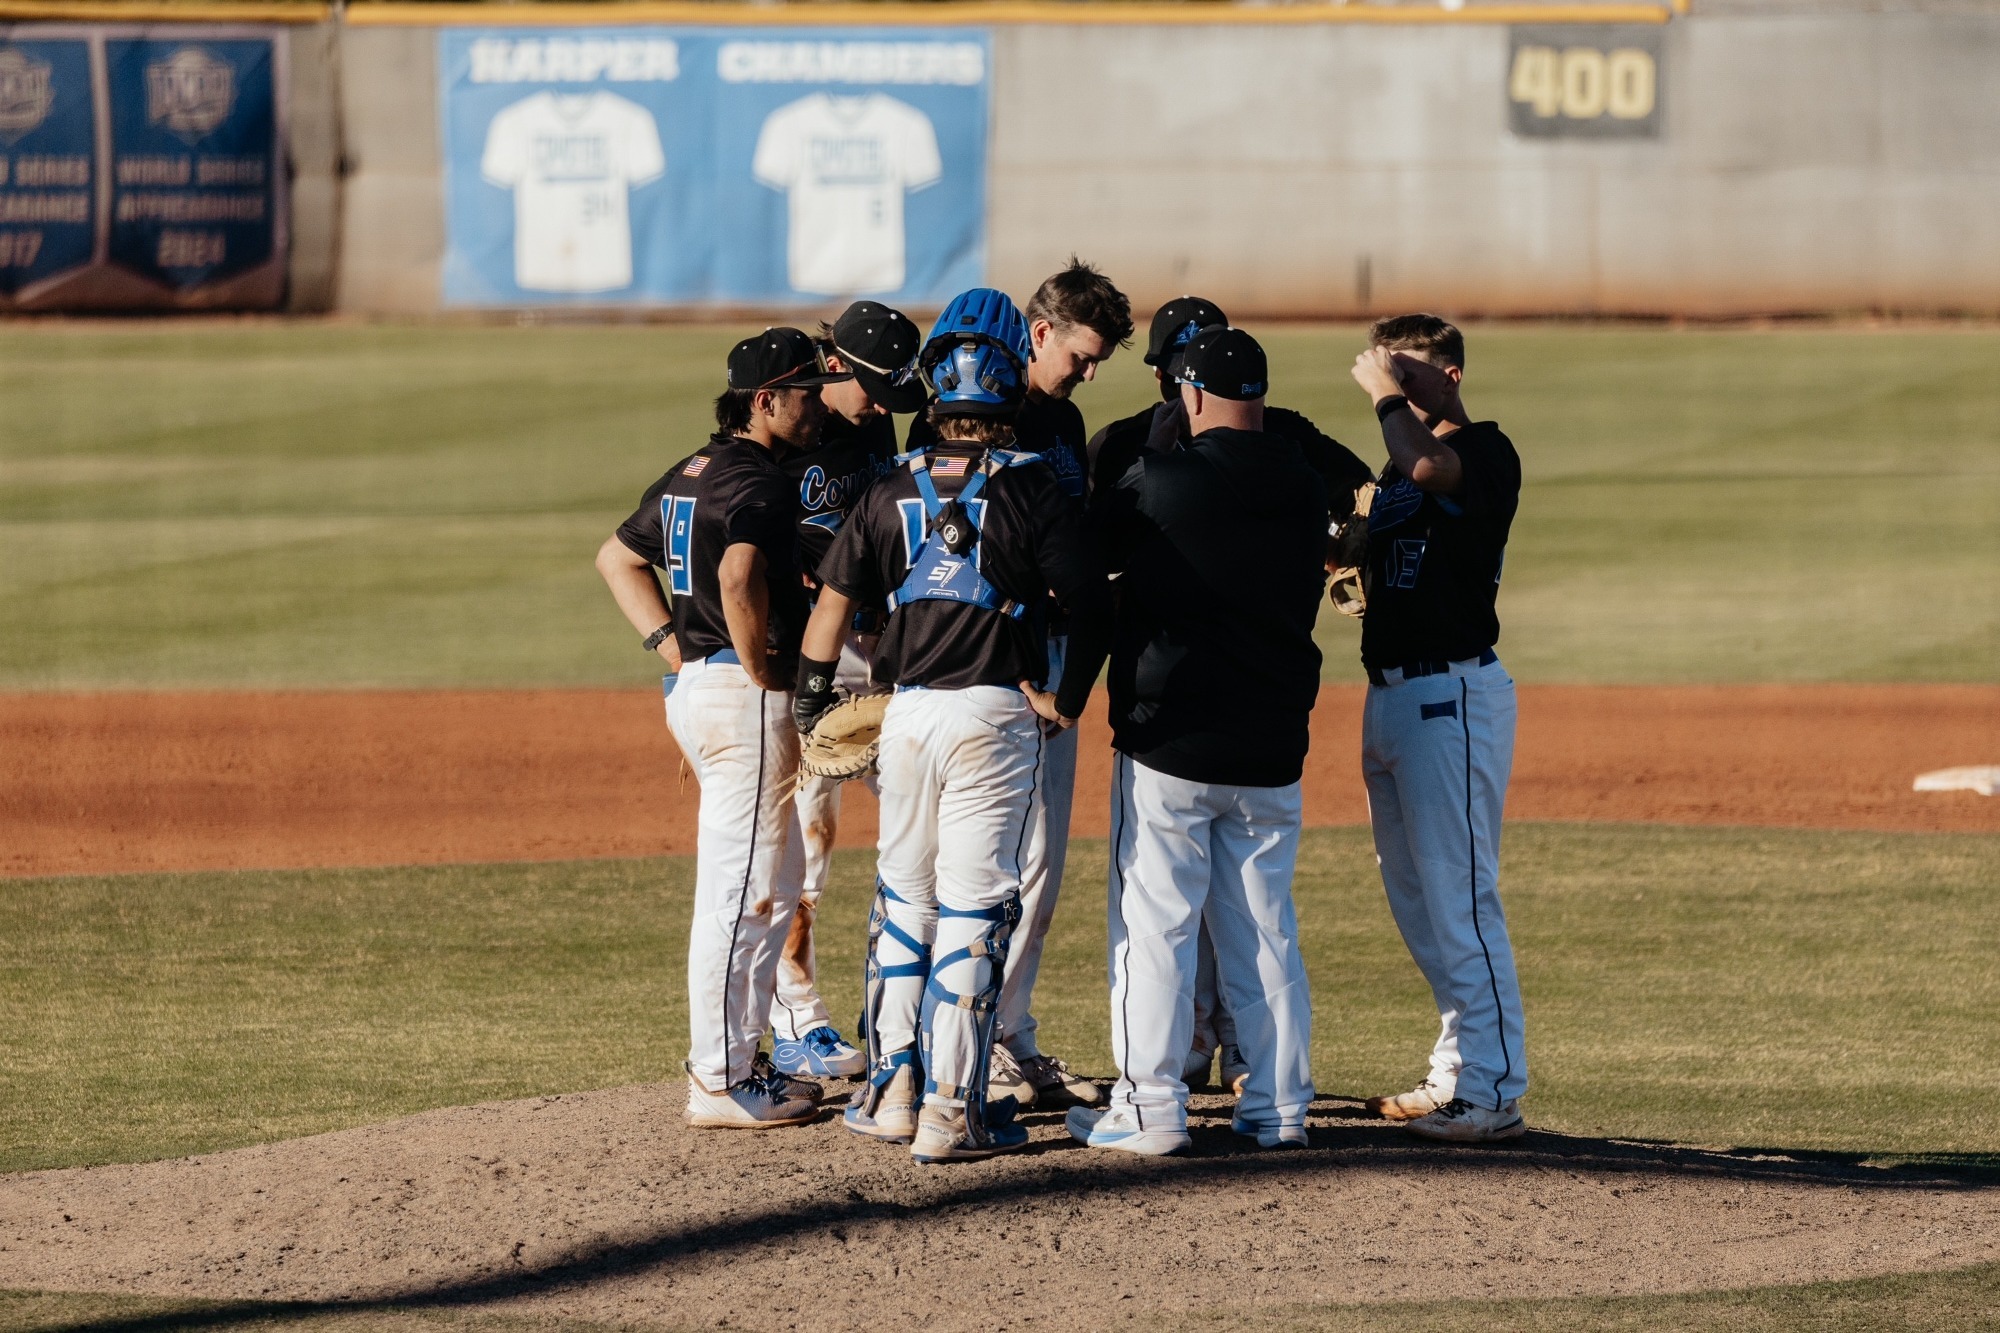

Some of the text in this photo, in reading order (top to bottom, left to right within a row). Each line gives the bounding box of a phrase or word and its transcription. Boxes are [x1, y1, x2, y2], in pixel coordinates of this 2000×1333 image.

[468, 38, 680, 83] HARPER
[716, 41, 984, 86] CHAMBERS
[1510, 45, 1656, 119] 400
[0, 193, 90, 222] ARANCE
